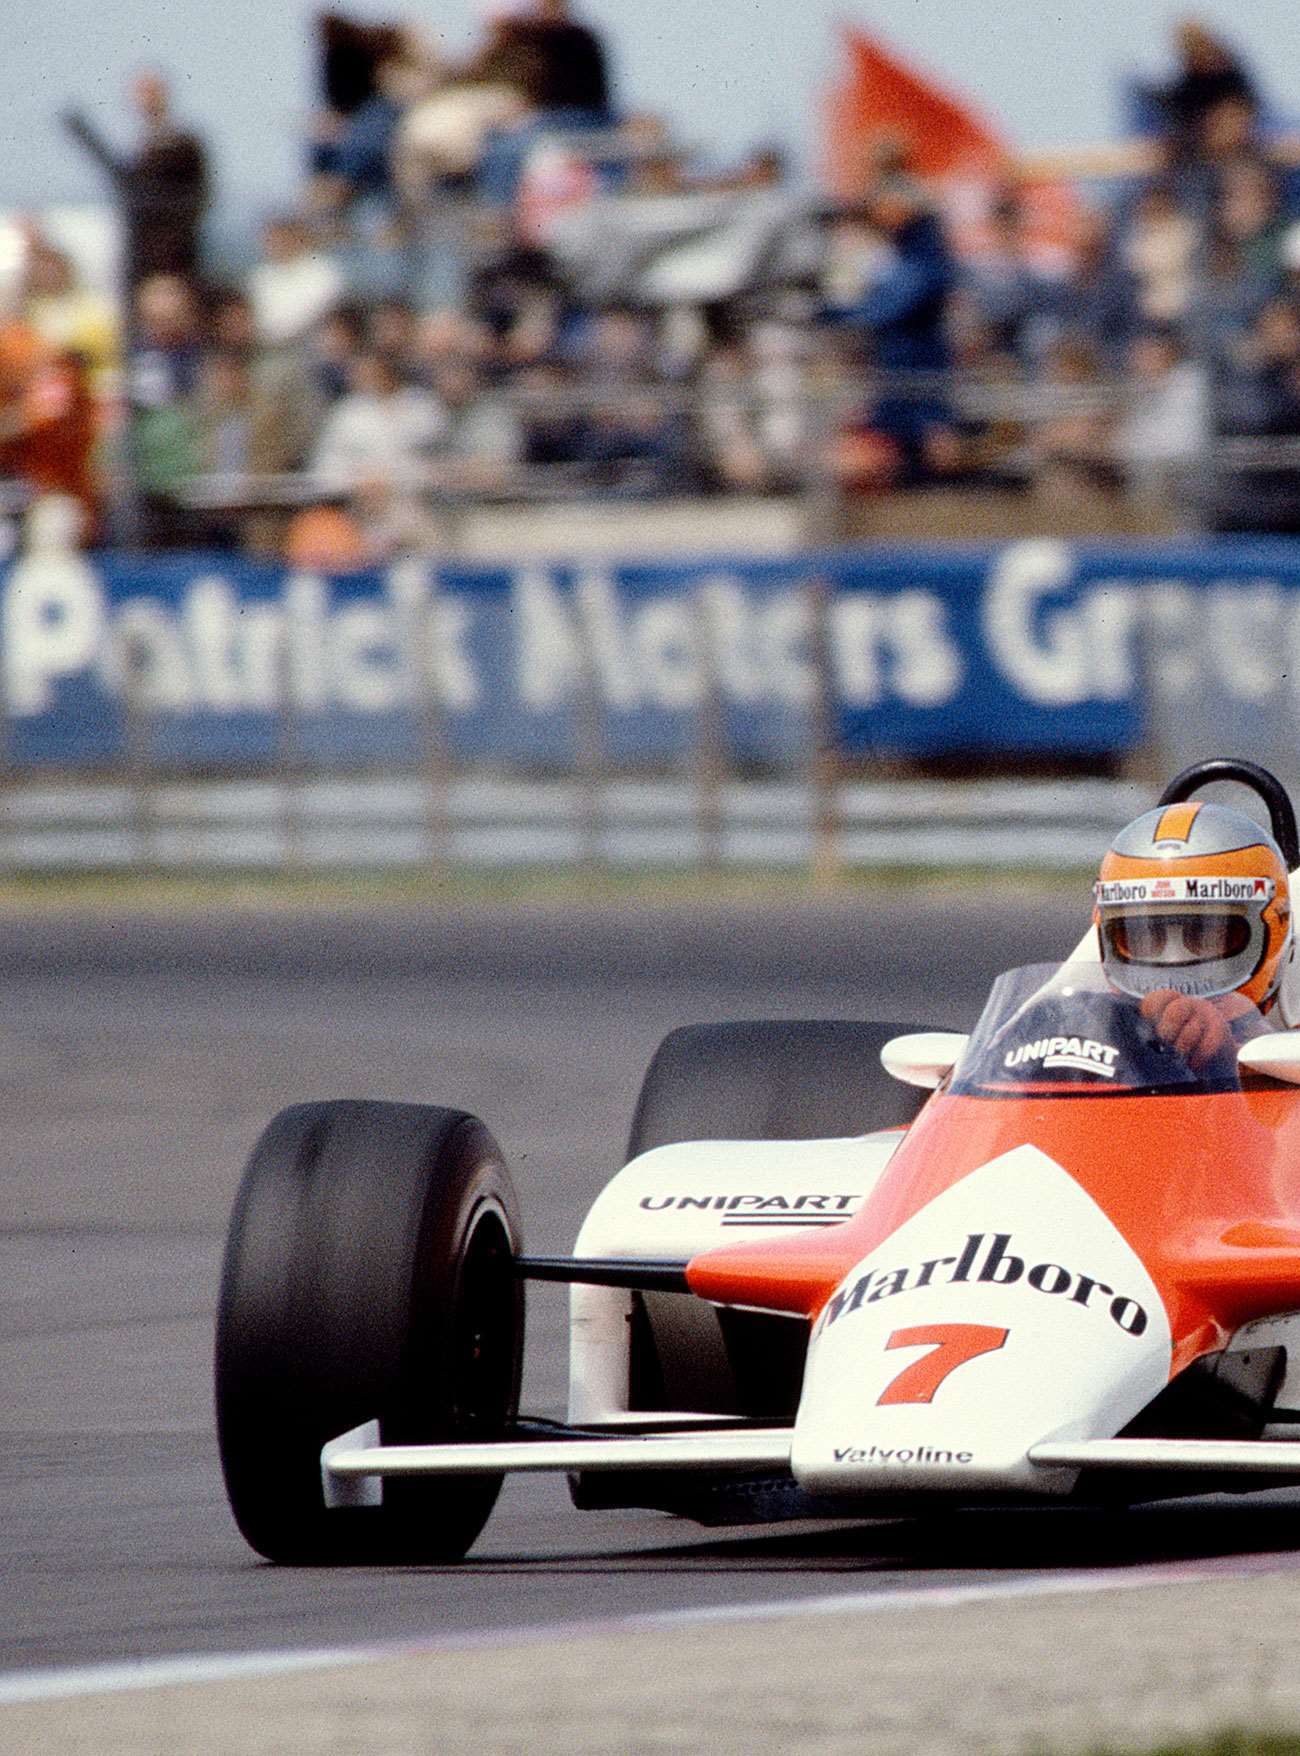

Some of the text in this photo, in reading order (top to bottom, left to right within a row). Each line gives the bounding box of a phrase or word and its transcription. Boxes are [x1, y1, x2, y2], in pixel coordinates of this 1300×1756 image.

[1186, 879, 1252, 898] Marlboro
[1004, 1037, 1120, 1068] UNIPART
[639, 1195, 863, 1210] UNIPART
[815, 1233, 1148, 1342] Marlboro
[876, 1323, 1010, 1406] 7
[833, 1446, 974, 1463] Valvoline
